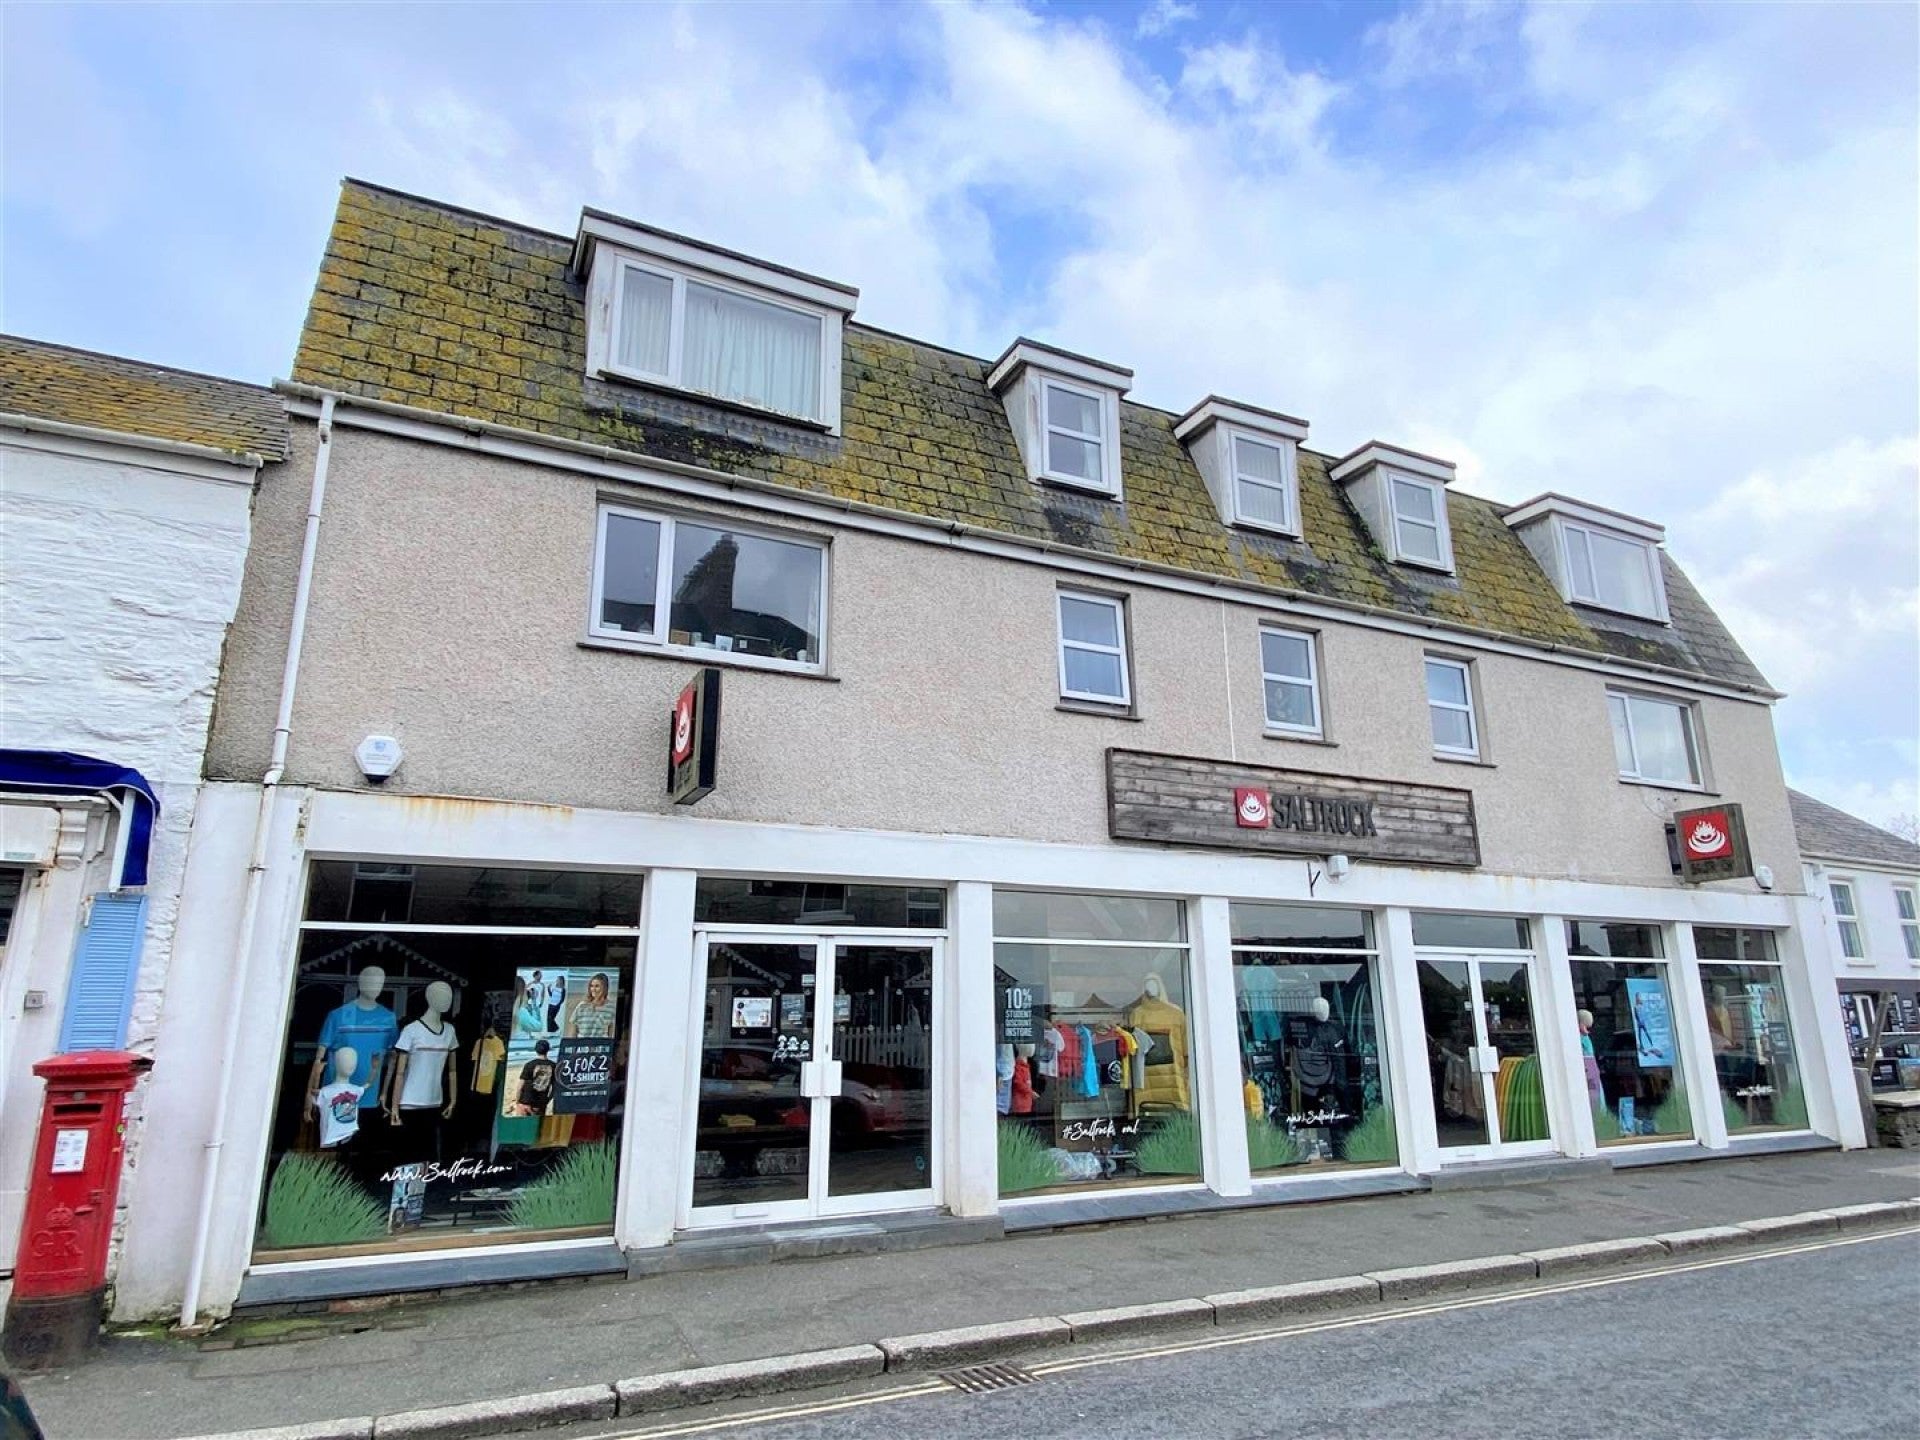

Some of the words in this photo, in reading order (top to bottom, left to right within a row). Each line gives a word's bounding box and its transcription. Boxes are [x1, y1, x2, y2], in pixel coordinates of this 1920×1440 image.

[1272, 795, 1378, 836] SALTROCK
[1005, 987, 1032, 1009] 10%
[562, 1059, 571, 1076] 3
[574, 1055, 596, 1072] FOR
[599, 1054, 608, 1070] 2
[570, 1071, 605, 1083] T-SHIRTS
[380, 1156, 513, 1183] www.Saltrock.com
